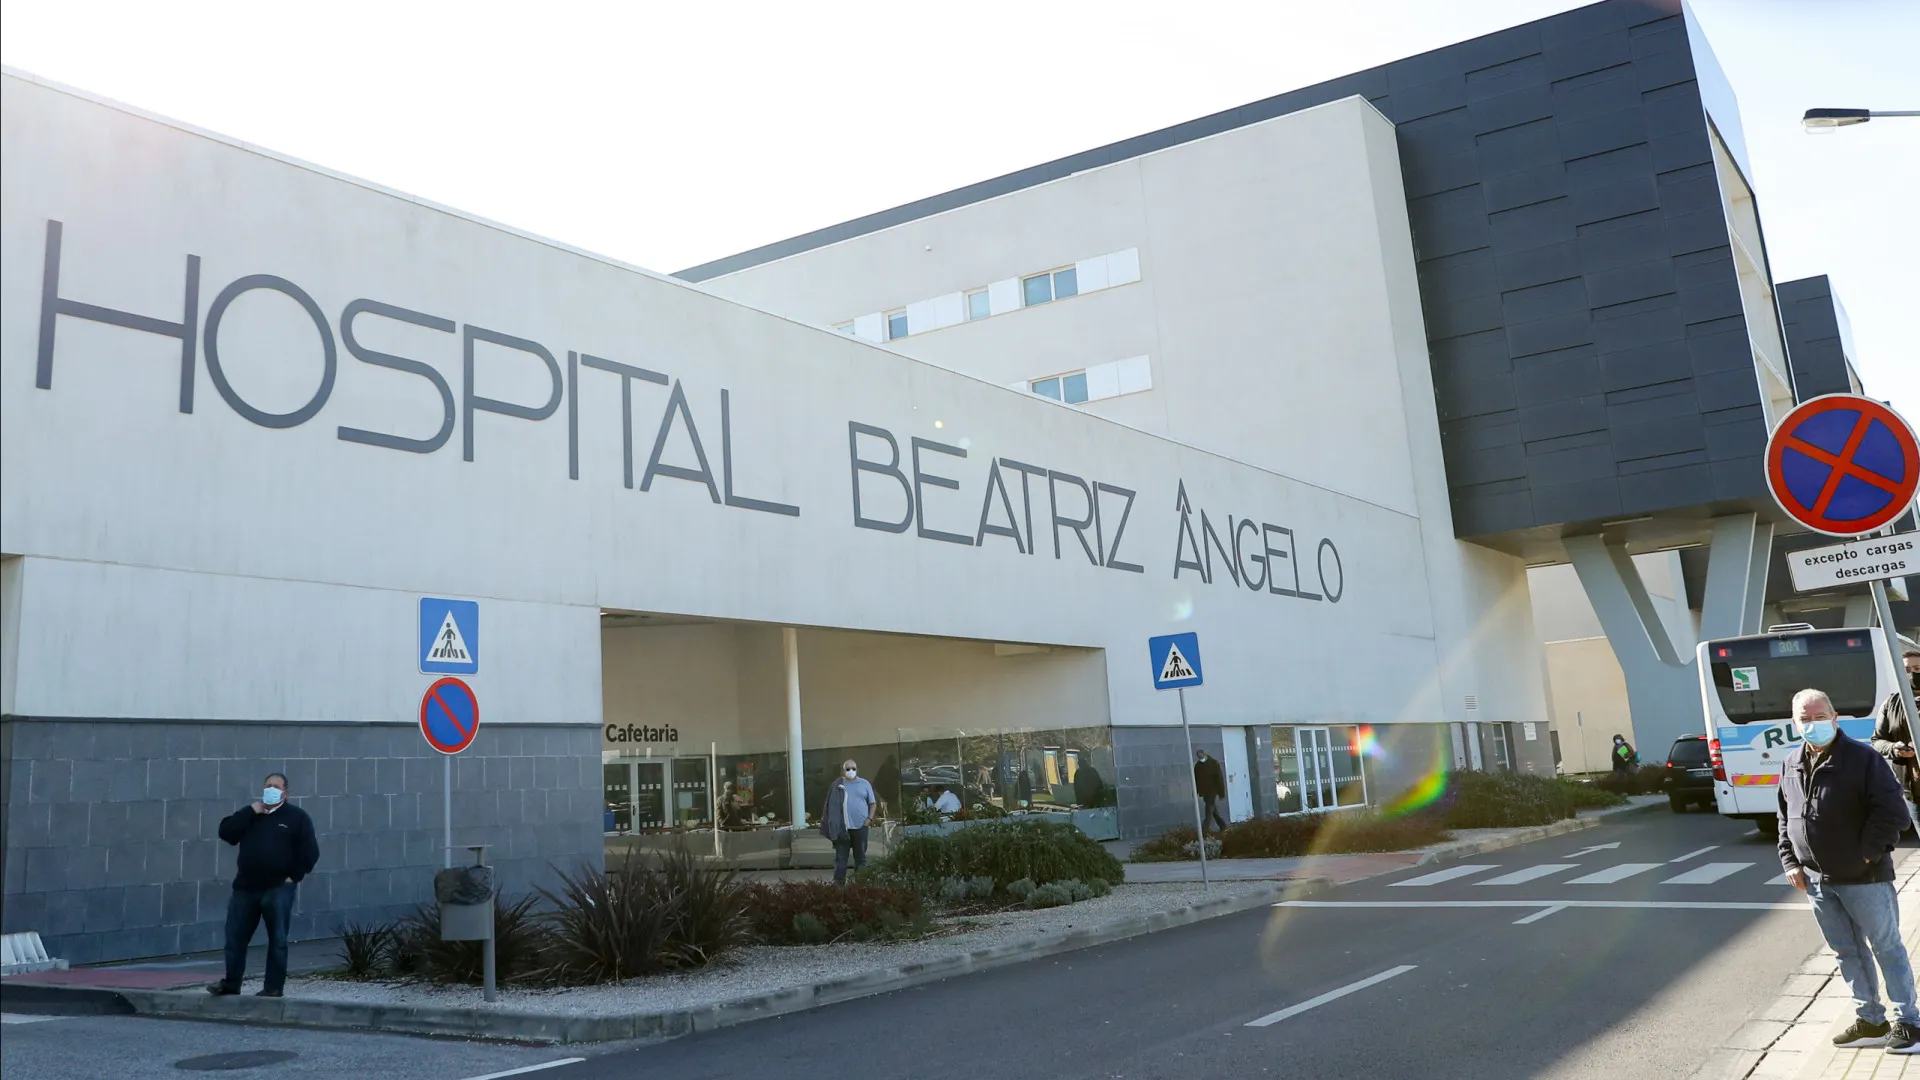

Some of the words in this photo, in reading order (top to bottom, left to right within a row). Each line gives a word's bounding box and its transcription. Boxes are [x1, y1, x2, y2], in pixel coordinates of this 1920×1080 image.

[36, 219, 800, 516] HOSPITAL
[848, 420, 1144, 573] BEATRIZ
[1174, 478, 1343, 603] ÂNGELO
[1804, 550, 1858, 566] excepto
[1866, 541, 1914, 556] cargas
[1835, 561, 1907, 579] descargas
[605, 723, 679, 743] Cafetaria
